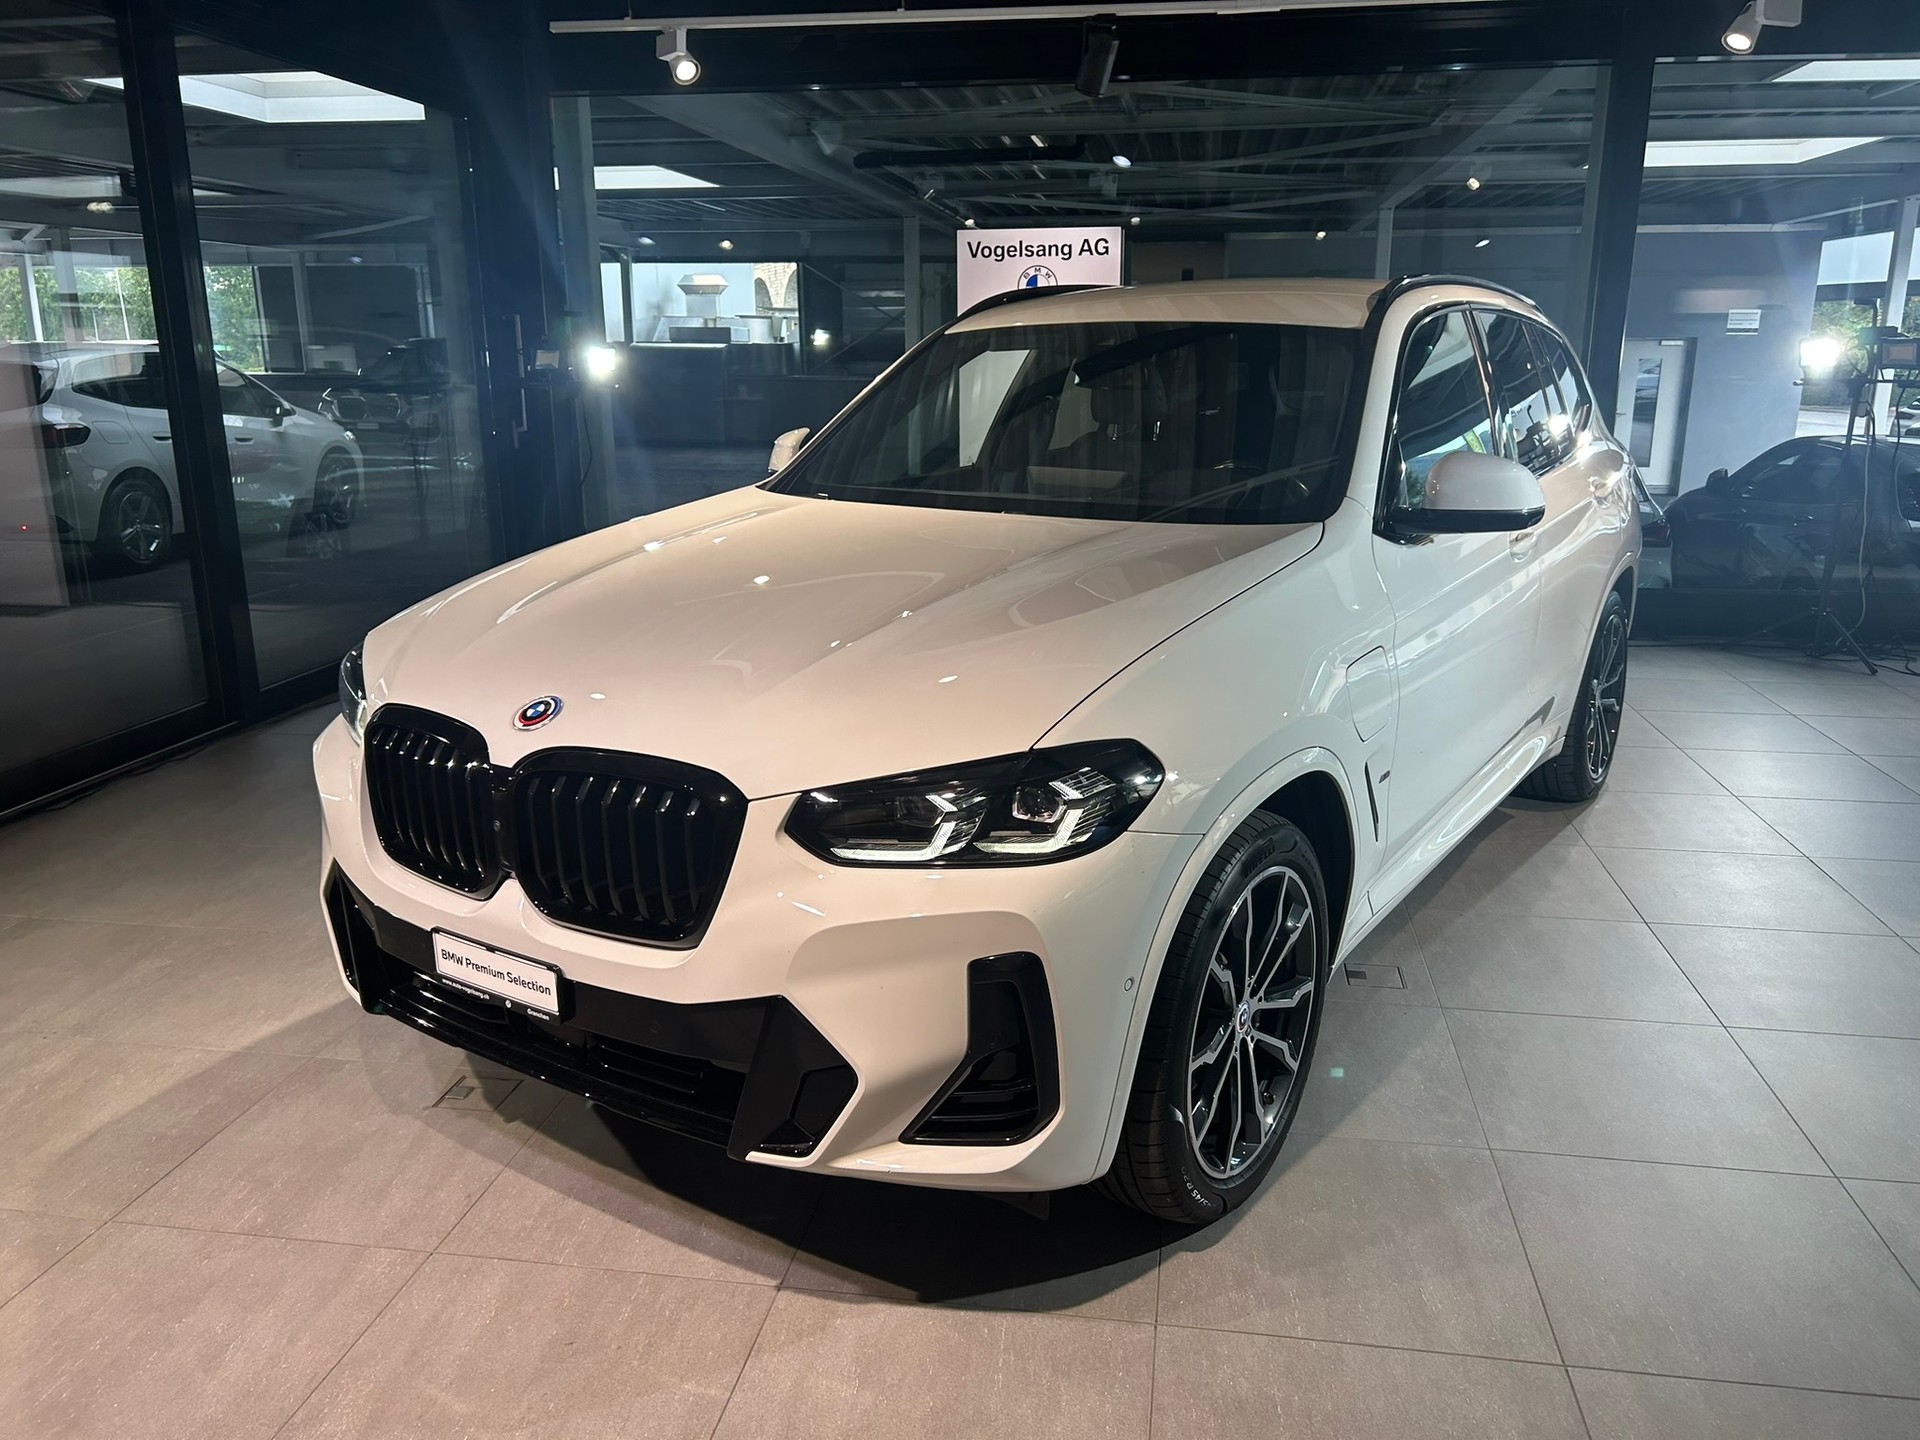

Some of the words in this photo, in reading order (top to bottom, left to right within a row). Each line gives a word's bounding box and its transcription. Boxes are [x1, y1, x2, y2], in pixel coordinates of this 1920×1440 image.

[967, 240, 1073, 262] Vogelsang
[1078, 238, 1110, 256] AG
[1023, 267, 1053, 280] BMW
[441, 949, 463, 966] BMW
[465, 957, 505, 980] Premium
[506, 971, 551, 996] Selection
